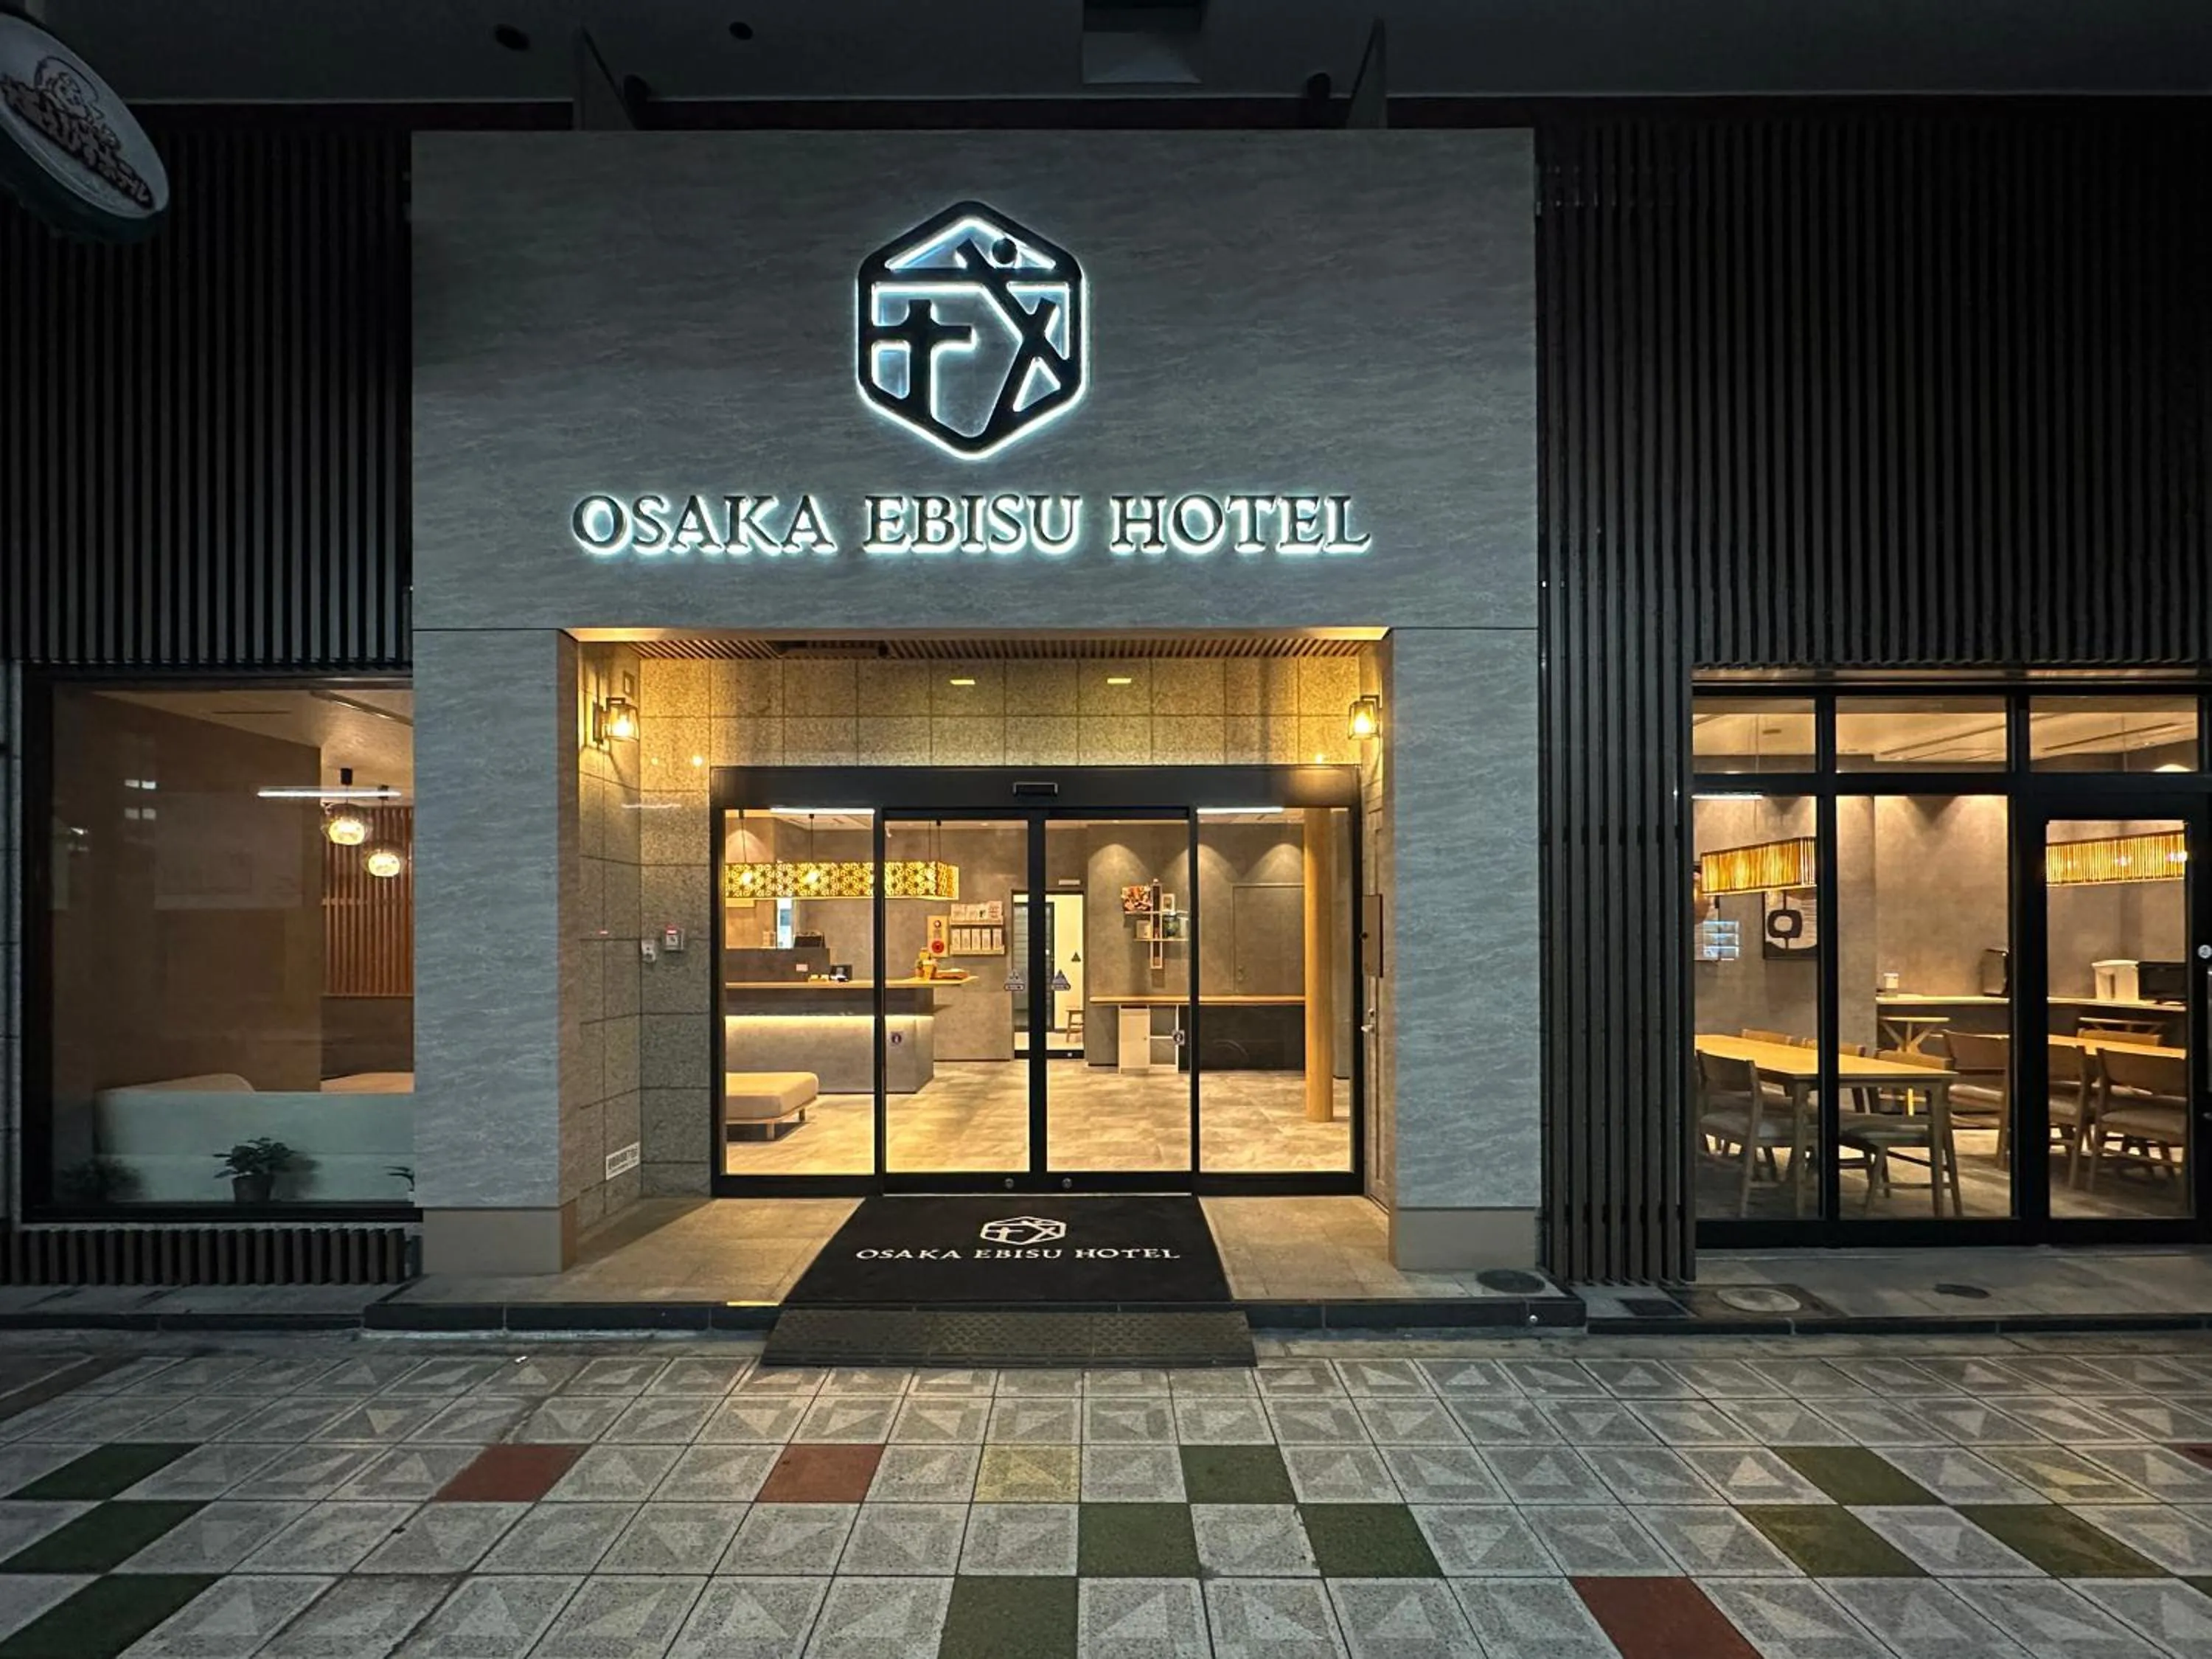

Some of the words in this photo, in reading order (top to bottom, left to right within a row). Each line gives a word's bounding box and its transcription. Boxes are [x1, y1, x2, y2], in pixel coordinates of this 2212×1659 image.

[572, 494, 836, 553] OSAKA
[863, 494, 1082, 553] EBISU
[1110, 494, 1371, 553] HOTEL
[856, 1249, 961, 1259] OSAKA
[974, 1249, 1062, 1259] EBISU
[1074, 1249, 1180, 1259] HOTEL
